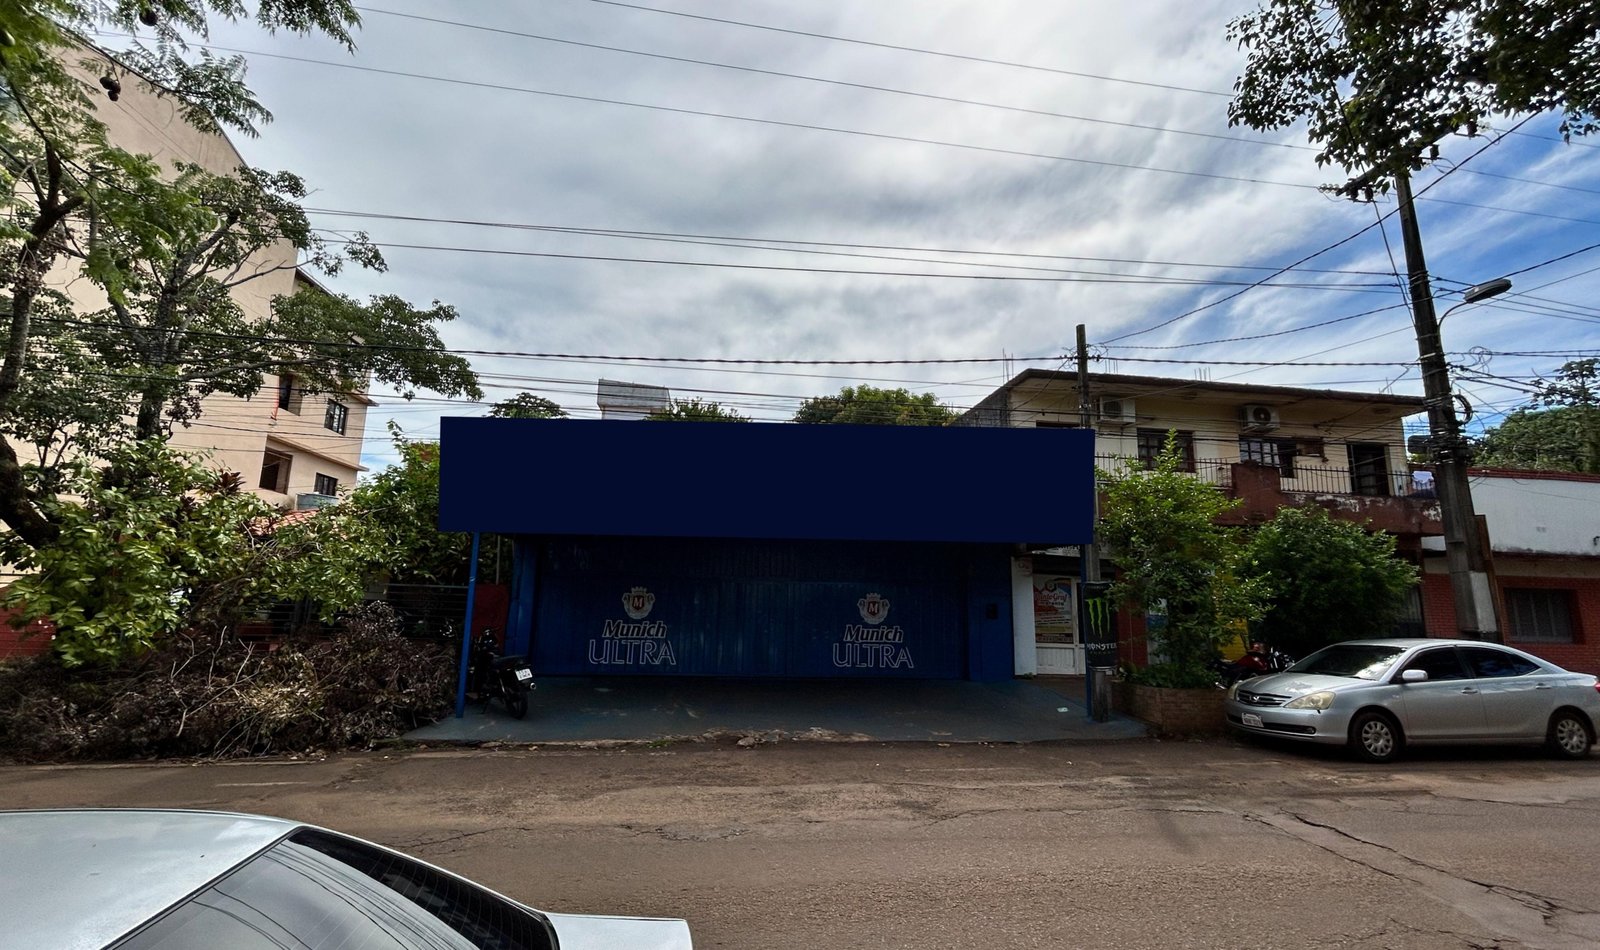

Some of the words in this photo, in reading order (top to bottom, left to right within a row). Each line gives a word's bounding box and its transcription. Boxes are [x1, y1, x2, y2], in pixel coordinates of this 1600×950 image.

[633, 597, 643, 607] M
[868, 602, 878, 613] M
[602, 619, 667, 639] Munich
[843, 624, 904, 643] Munich
[588, 639, 676, 665] ULTRA
[833, 643, 914, 669] ULTRA
